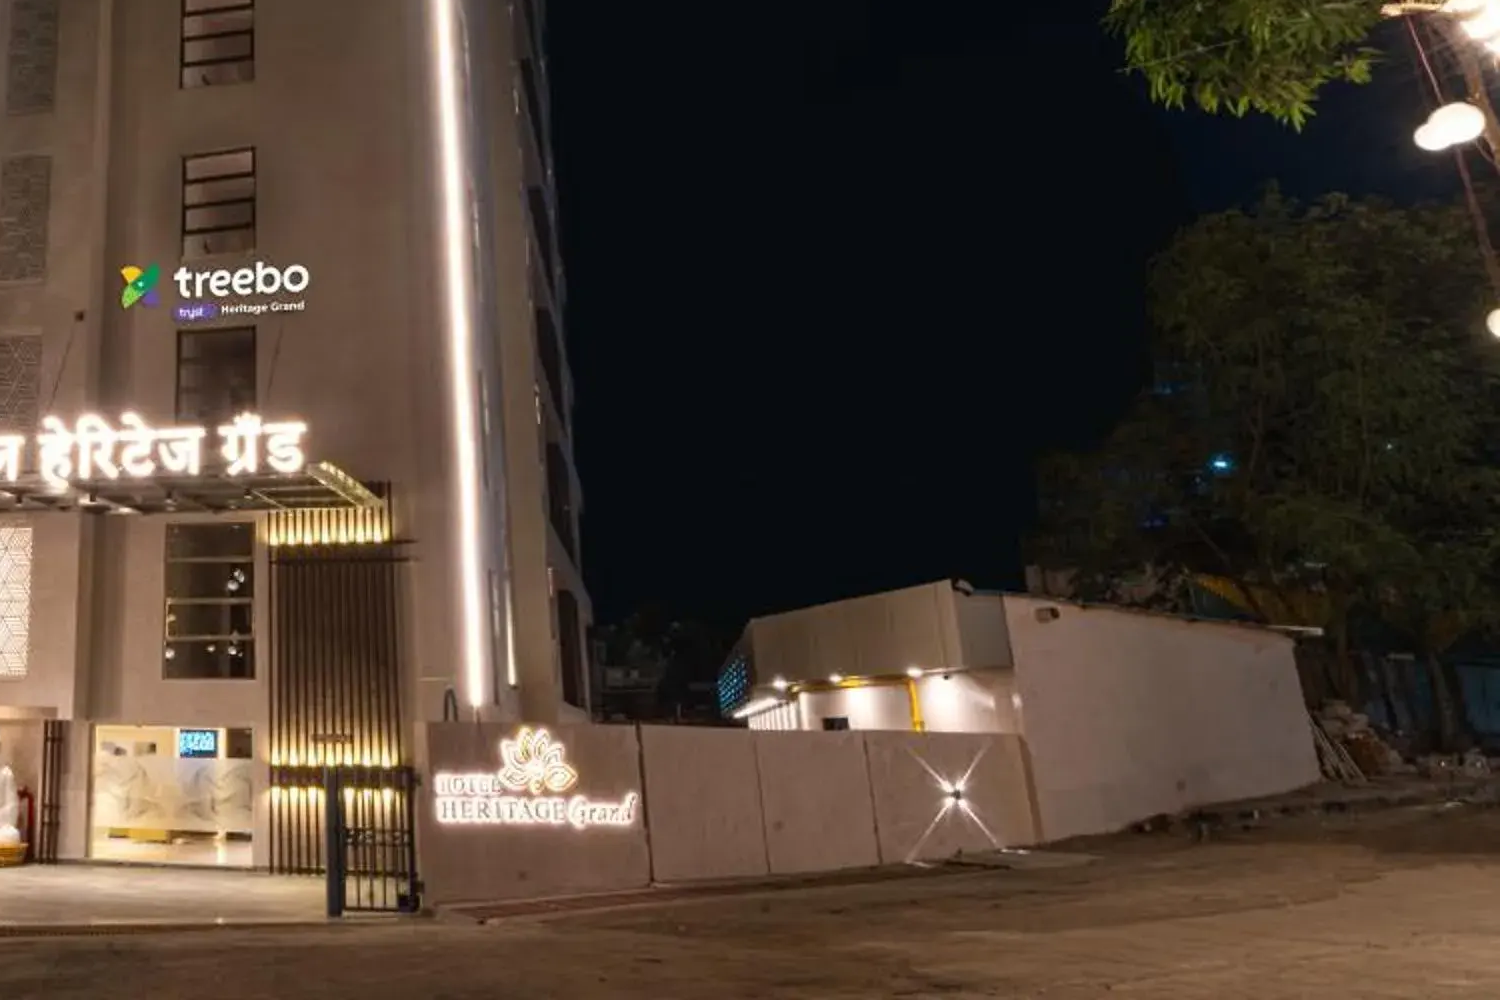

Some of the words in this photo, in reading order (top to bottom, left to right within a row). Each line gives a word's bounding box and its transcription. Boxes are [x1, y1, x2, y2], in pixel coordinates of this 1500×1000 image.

[173, 261, 309, 298] treebo
[221, 304, 268, 316] Heritage
[270, 300, 305, 312] Grand
[37, 412, 206, 493] हेरिटेज
[438, 798, 566, 823] HERITAGE
[568, 793, 639, 829] Grand
